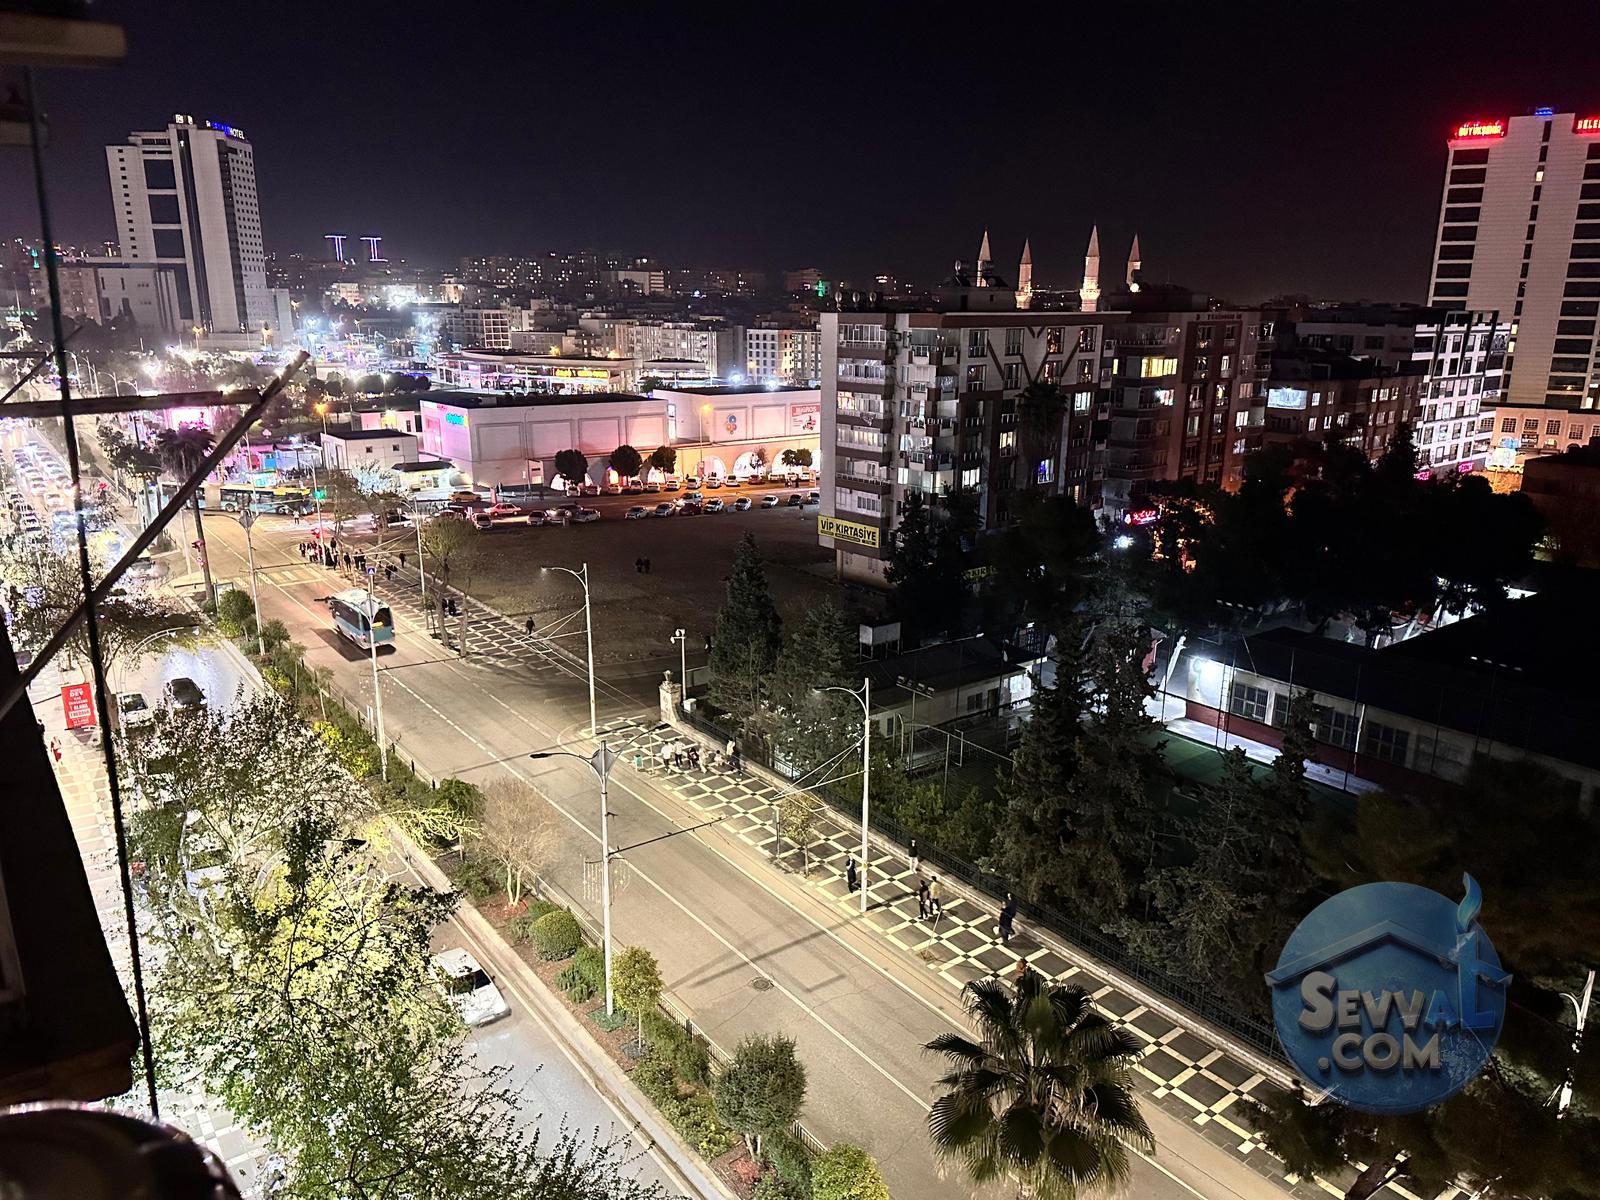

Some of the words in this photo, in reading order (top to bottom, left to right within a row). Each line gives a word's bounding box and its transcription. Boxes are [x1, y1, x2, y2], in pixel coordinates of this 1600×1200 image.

[230, 128, 244, 139] HOTEL
[821, 519, 834, 530] VİP
[836, 523, 877, 541] KIRTASİYE
